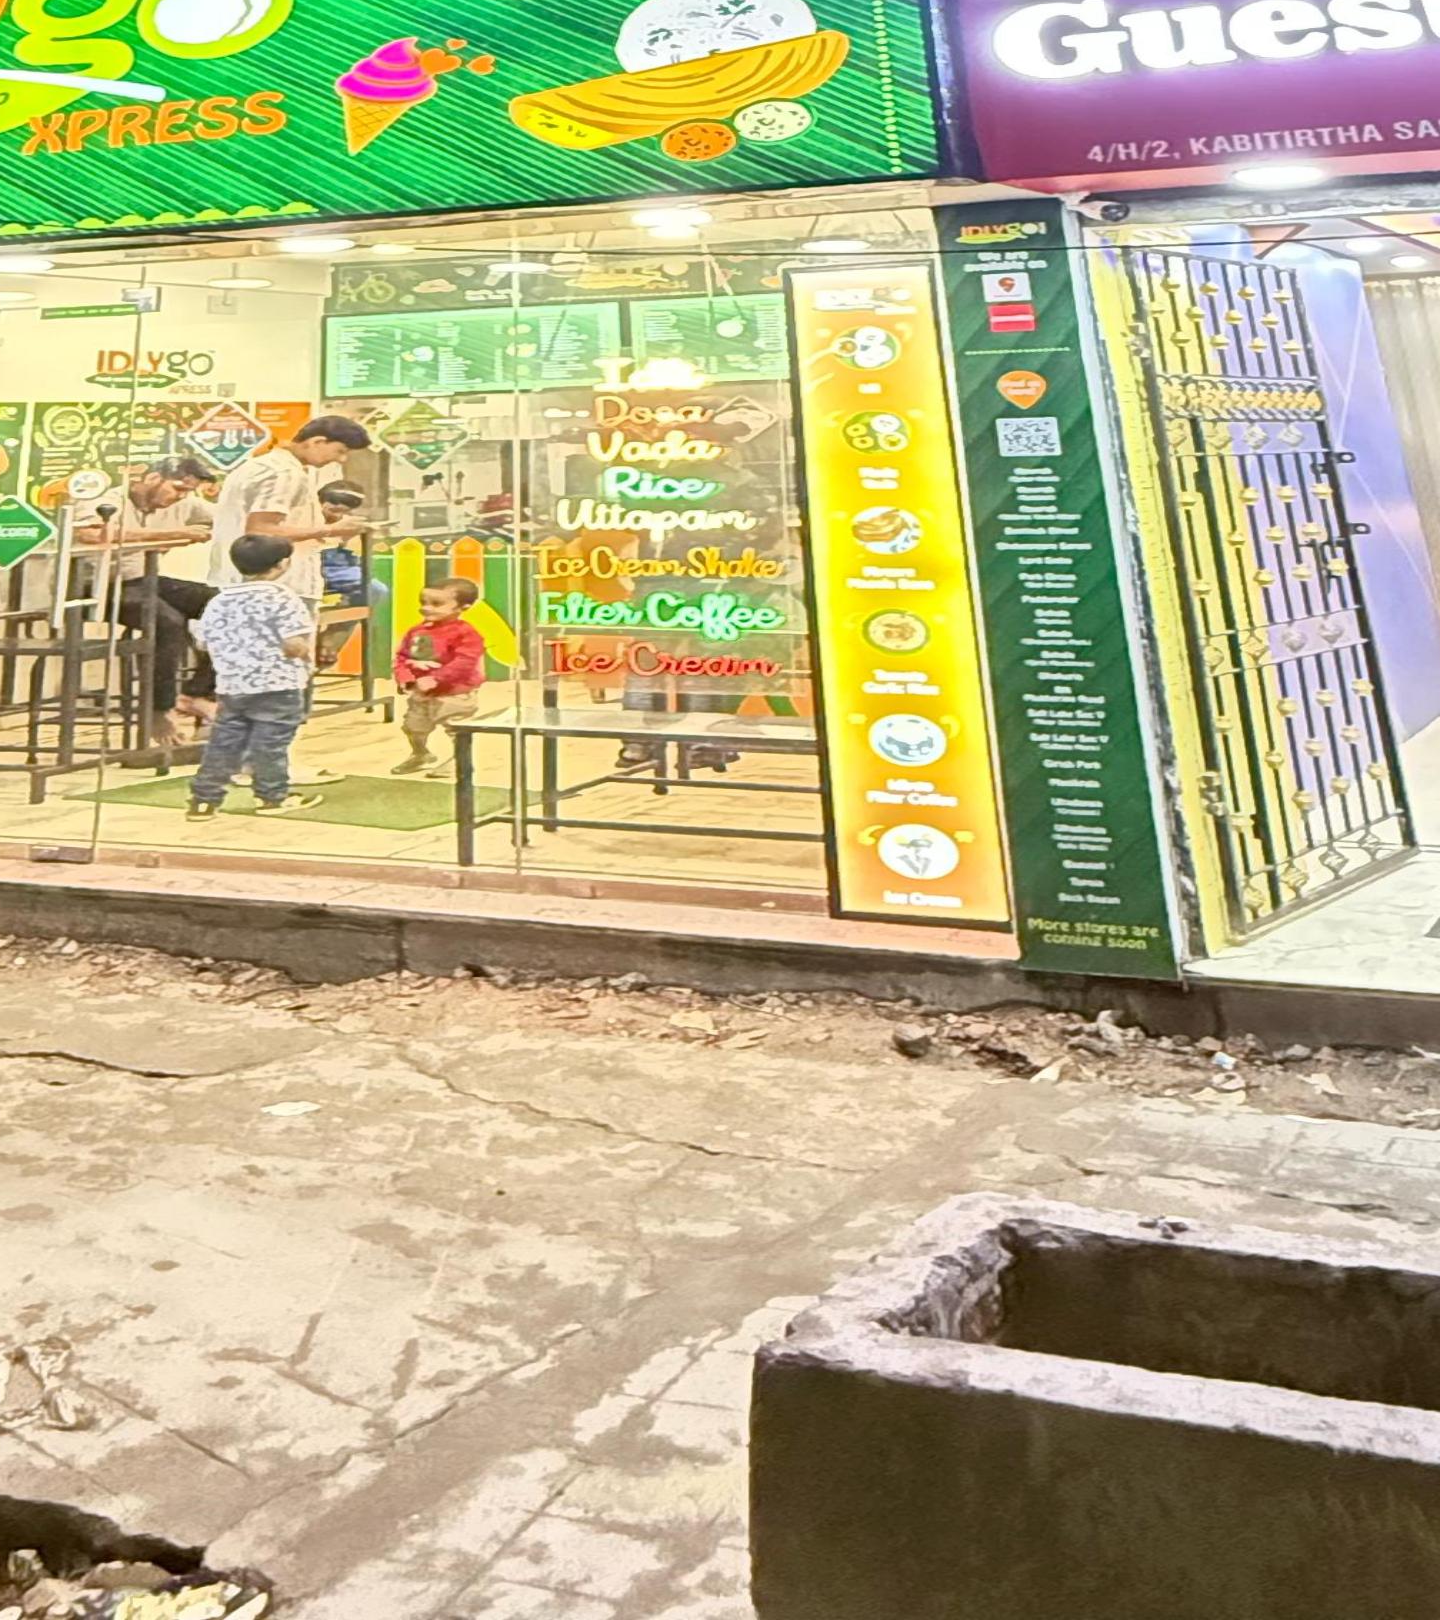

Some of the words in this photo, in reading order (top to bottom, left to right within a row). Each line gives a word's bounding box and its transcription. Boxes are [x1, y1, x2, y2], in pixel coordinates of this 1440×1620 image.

[22, 91, 287, 156] XPRESS
[1086, 140, 1180, 163] 4/H/2,
[1189, 123, 1383, 155] KABITIRTHA
[603, 466, 718, 501] Rice
[532, 545, 591, 579] Ice
[589, 546, 687, 579] Cream
[687, 546, 785, 579] Shake
[537, 591, 643, 626] Filter
[646, 591, 787, 642] Coffee
[544, 639, 625, 676] Ice
[628, 641, 784, 677] Cream
[1027, 918, 1070, 930] More
[1074, 920, 1127, 936] stores
[1131, 925, 1160, 938] are
[1043, 932, 1103, 947] coming
[1107, 938, 1148, 950] soon
